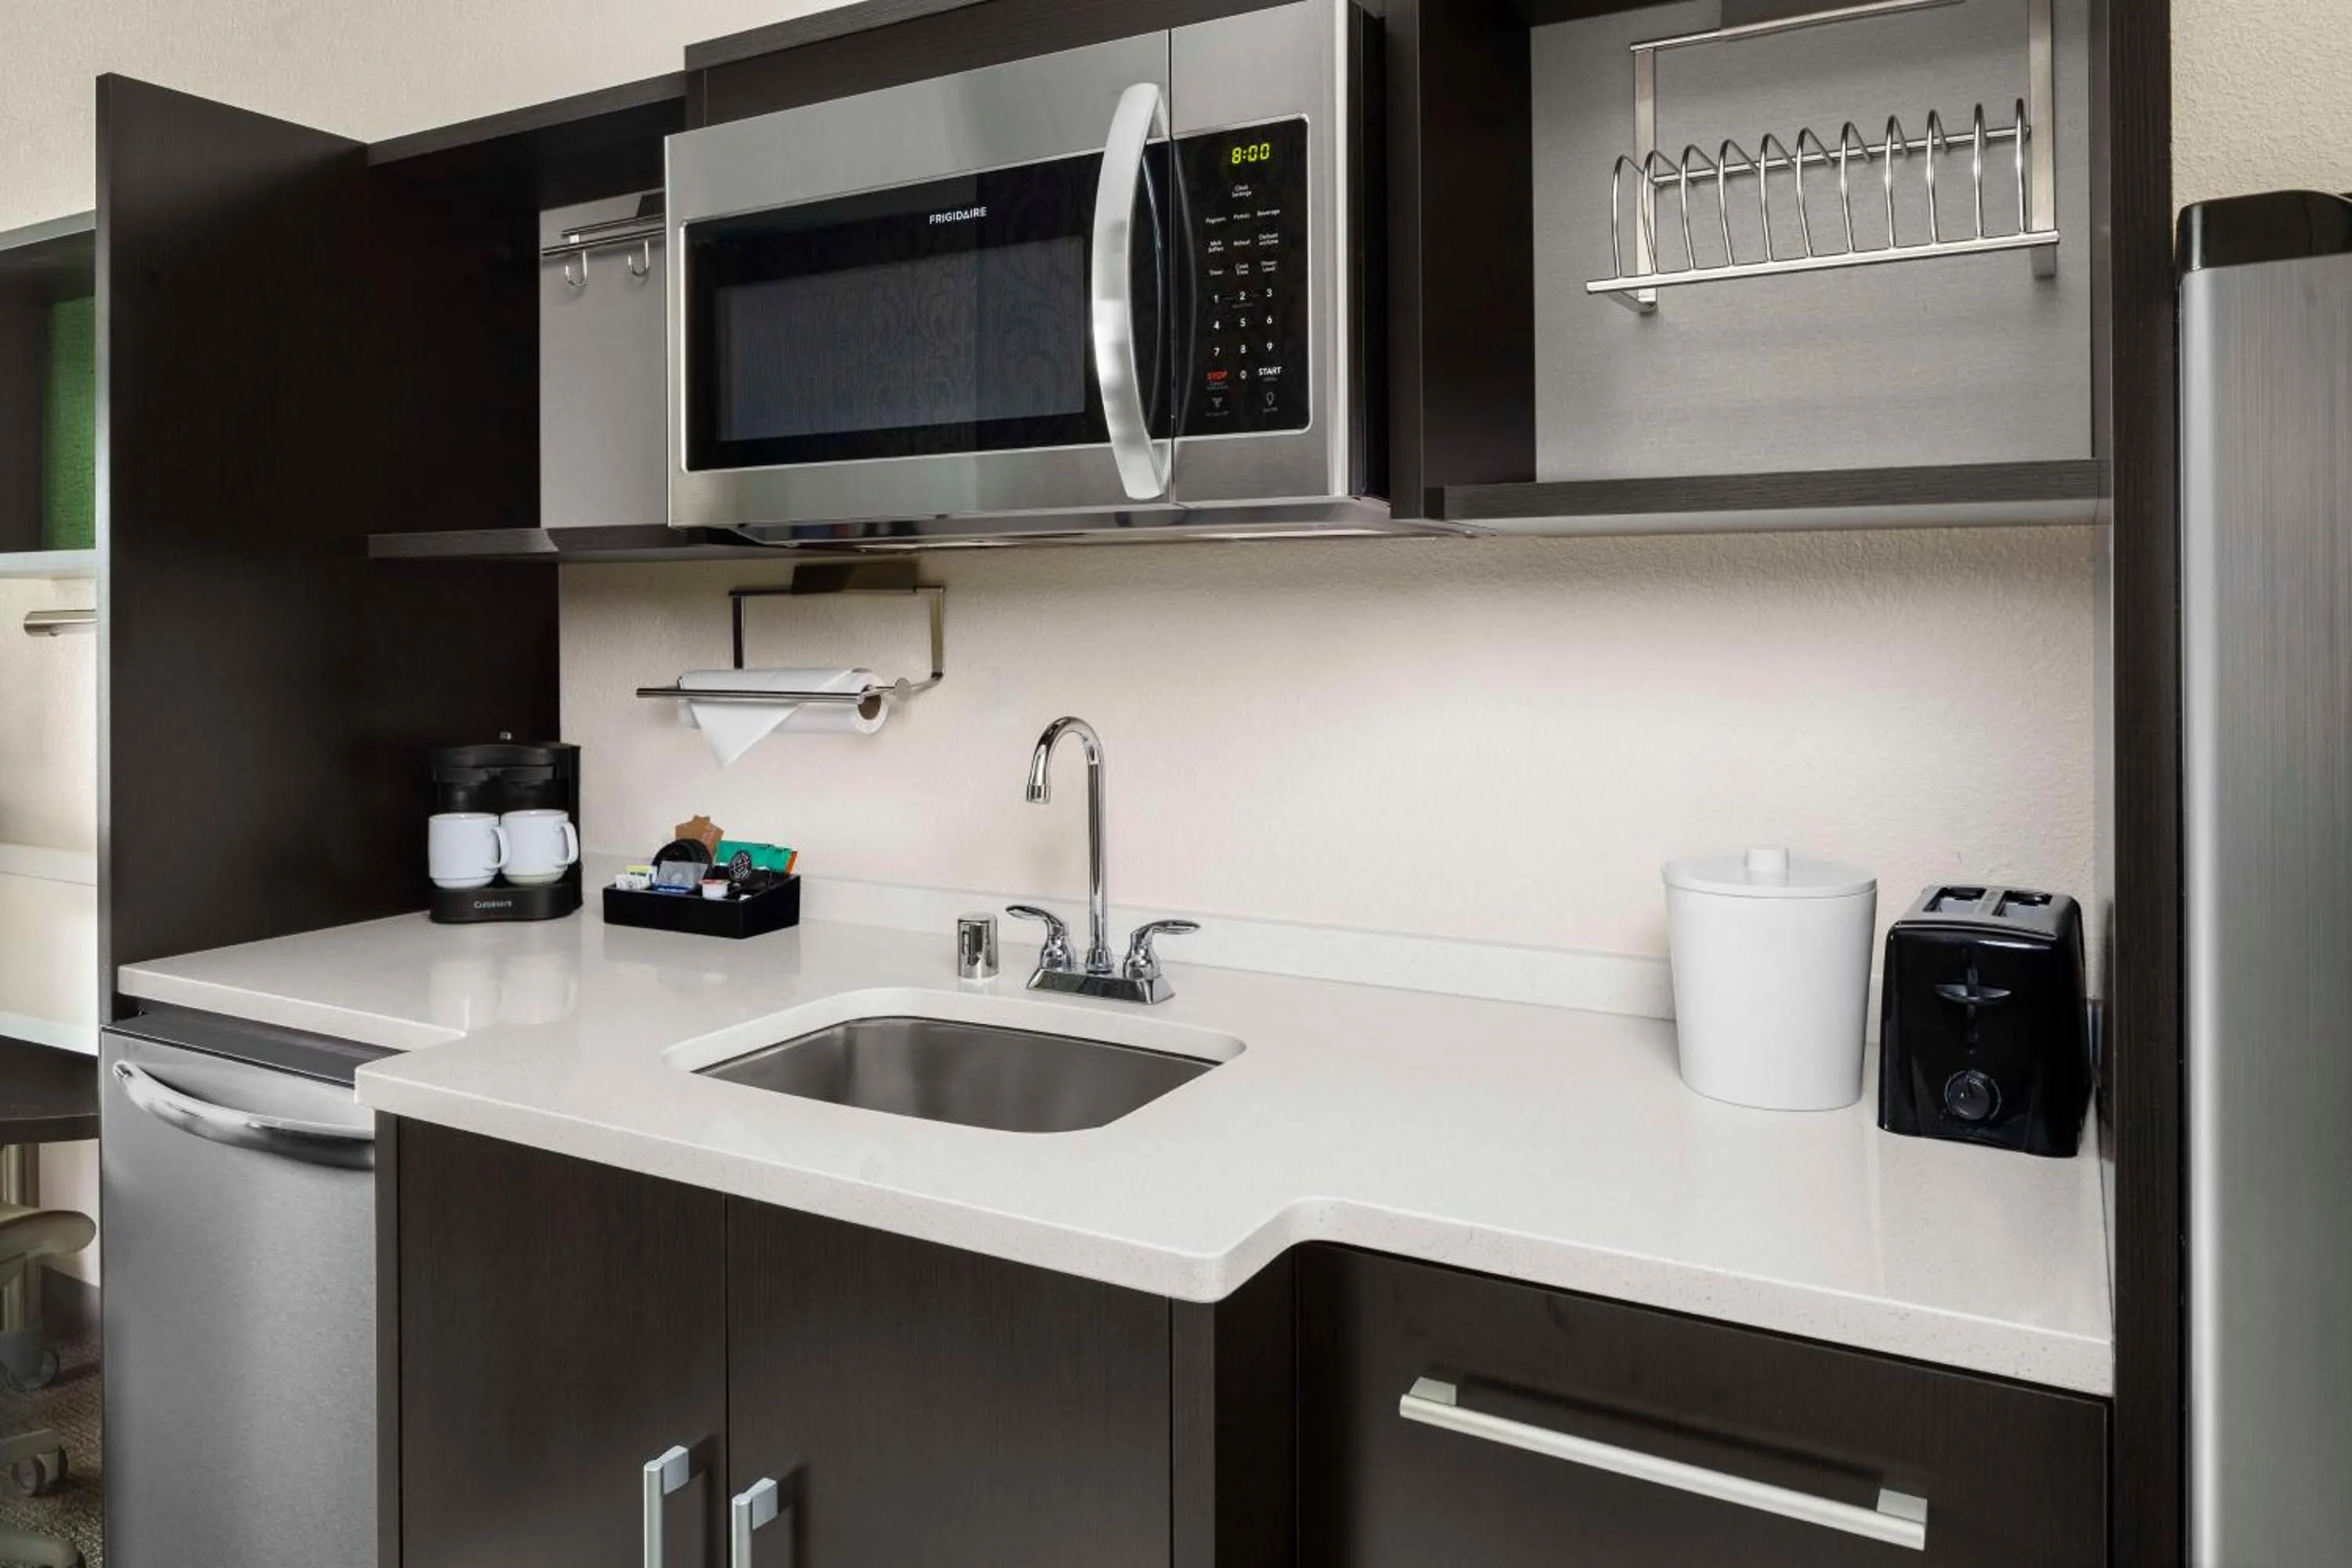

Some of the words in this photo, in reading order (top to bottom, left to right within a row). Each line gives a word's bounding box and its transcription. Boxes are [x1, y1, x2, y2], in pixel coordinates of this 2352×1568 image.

[1232, 143, 1270, 164] 8:00
[929, 206, 988, 225] FRIGIDAIRE
[1257, 209, 1280, 217] Beverage
[1239, 291, 1246, 300] 2
[1266, 289, 1272, 297] 3
[1214, 295, 1218, 303] 1
[1240, 318, 1246, 327] 5
[1266, 315, 1272, 324] 6
[1213, 321, 1220, 330] 4
[1240, 344, 1247, 354] 8
[1266, 342, 1273, 351] 9
[1214, 347, 1220, 357] 7
[1240, 370, 1247, 379] 0
[1258, 366, 1282, 376] START
[1207, 371, 1228, 381] STOP
